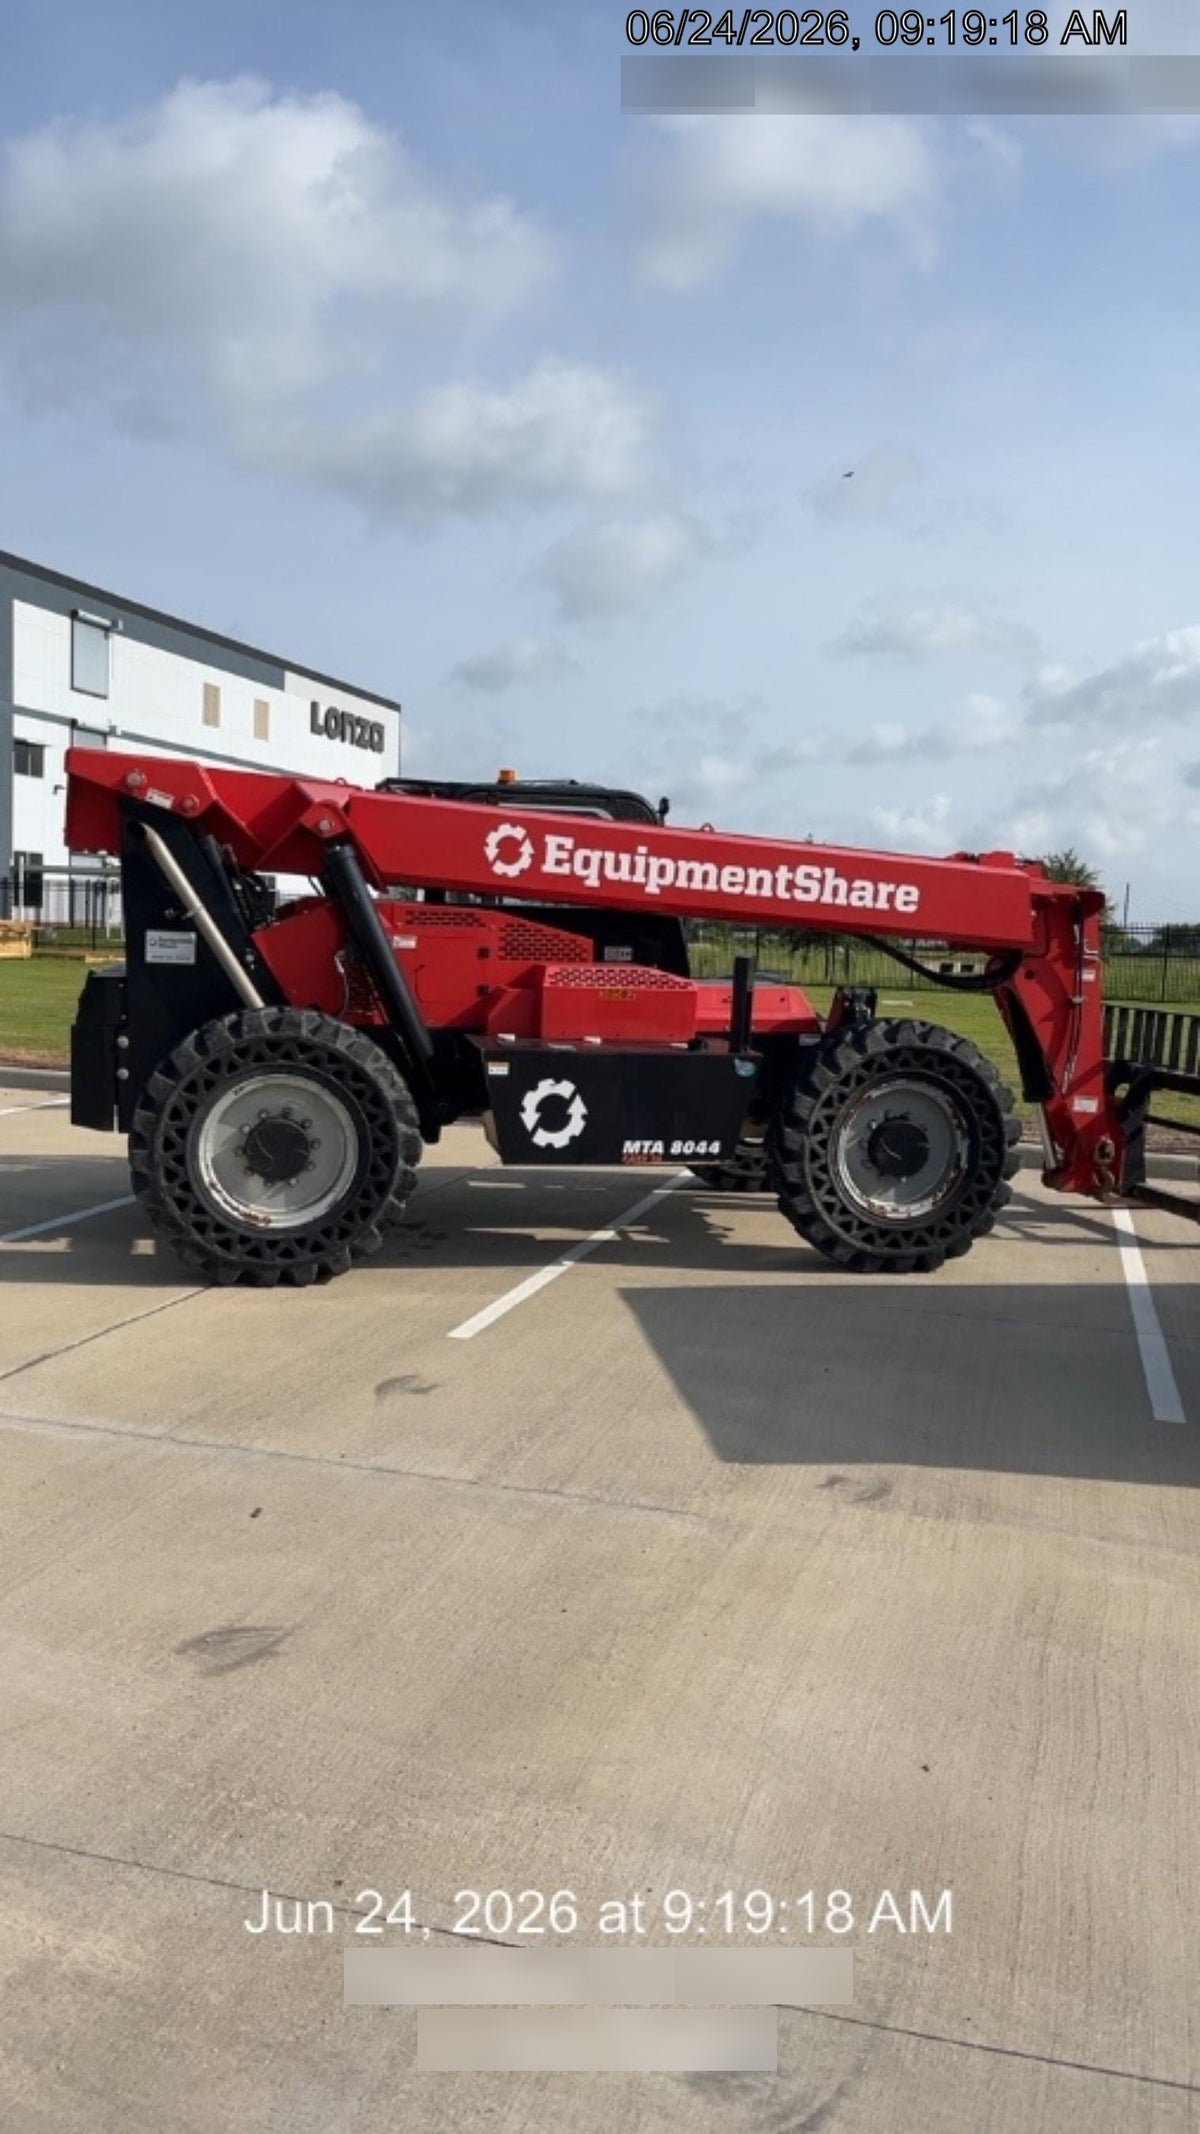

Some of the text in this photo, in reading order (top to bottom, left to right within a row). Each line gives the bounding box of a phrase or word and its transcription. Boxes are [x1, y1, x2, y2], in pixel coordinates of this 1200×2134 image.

[541, 833, 920, 913] EquipmentShare
[623, 1140, 721, 1155] MTA 8044
